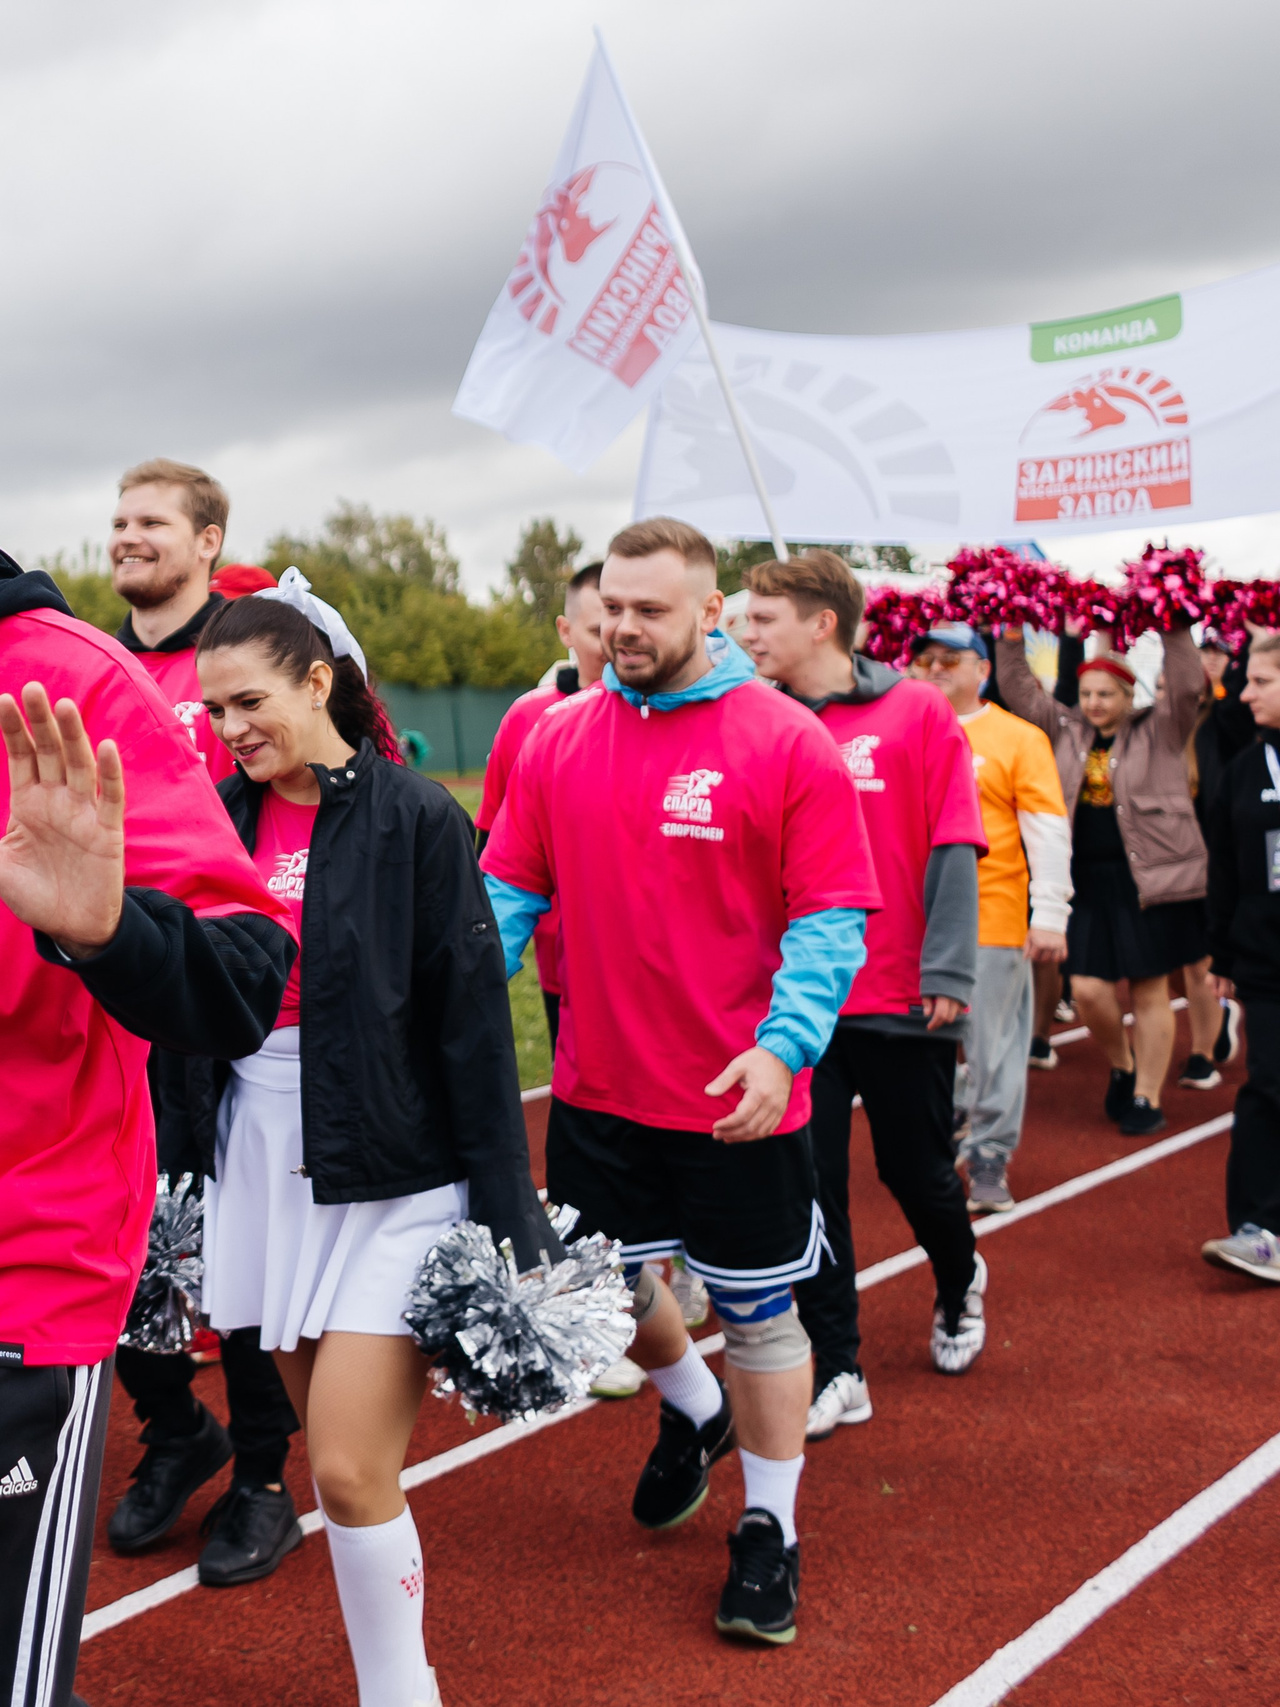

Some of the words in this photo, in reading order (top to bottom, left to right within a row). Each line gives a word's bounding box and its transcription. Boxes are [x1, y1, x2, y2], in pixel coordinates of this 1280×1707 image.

[1054, 318, 1157, 355] КОМАНДА
[1021, 439, 1188, 485] ЗАРИНСКИЙ
[1058, 487, 1153, 520] ЗАВОД
[663, 795, 712, 813] СПАРТА
[661, 823, 725, 842] СПОРТСМЕН
